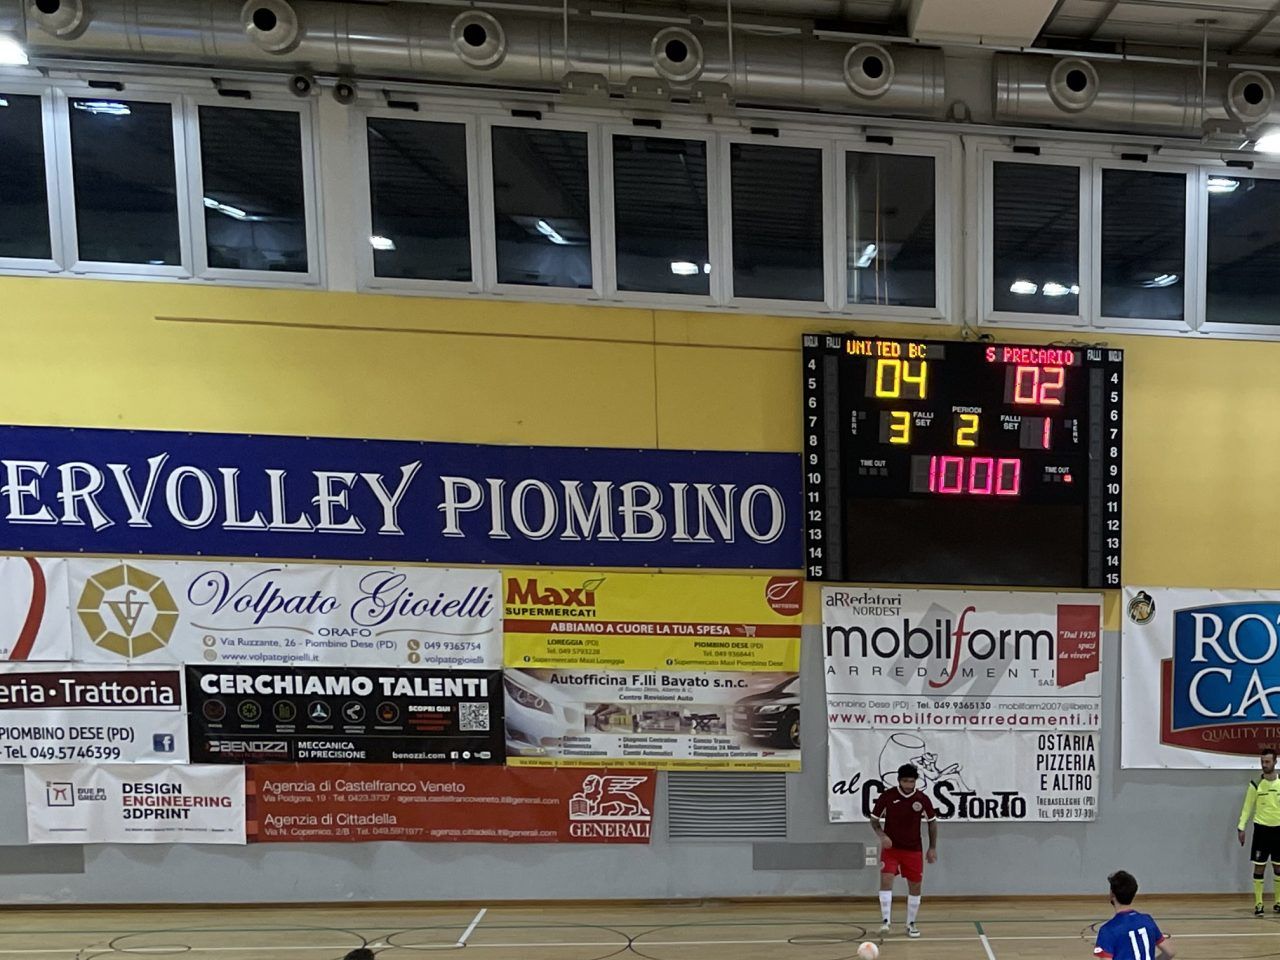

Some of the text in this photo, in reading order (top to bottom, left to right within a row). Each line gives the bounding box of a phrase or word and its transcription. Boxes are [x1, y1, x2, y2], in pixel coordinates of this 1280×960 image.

[908, 343, 927, 357] BC
[986, 347, 1075, 366] S PRECARIO
[808, 359, 816, 370] 4
[808, 378, 816, 389] 5
[874, 358, 928, 399] 04
[1110, 373, 1118, 384] 4
[1014, 365, 1064, 405] 02
[808, 397, 816, 408] 6
[1110, 392, 1118, 403] 5
[913, 411, 934, 419] FALLI
[952, 406, 982, 414] PERIODI
[1110, 410, 1118, 421] 6
[809, 416, 817, 427] 7
[1000, 415, 1021, 423] FALLI
[889, 411, 911, 443] 3
[956, 414, 979, 446] 2
[1042, 416, 1051, 449] 1
[1110, 429, 1118, 440] 7
[809, 435, 818, 446] 8
[1110, 447, 1118, 458] 8
[810, 454, 818, 465] 9
[1110, 465, 1118, 476] 9
[807, 473, 821, 484] 10
[1107, 483, 1120, 494] 10
[808, 492, 820, 502] 11
[437, 475, 786, 545] PIOMBINO
[1107, 501, 1119, 512] 11
[808, 510, 821, 521] 12
[1106, 520, 1120, 531] 12
[809, 529, 822, 540] 13
[1106, 538, 1119, 549] 13
[809, 547, 822, 558] 14
[1106, 556, 1119, 566] 14
[809, 565, 822, 577] 15
[1106, 574, 1119, 584] 15
[187, 568, 495, 627] Volpato Gioielli
[507, 577, 595, 607] Maxi
[505, 607, 597, 618] SUPERMERCATI
[852, 606, 902, 617] NORDEST
[318, 627, 372, 638] ORAFO
[550, 622, 731, 636] ABBIAMO A CUORE LA TUA SPESA
[220, 637, 235, 646] Via
[284, 638, 296, 647] 26
[305, 638, 348, 648] Piombino
[350, 640, 374, 649] Dese
[376, 640, 398, 650] (PD)
[424, 641, 481, 651] 049 9365754
[826, 606, 1054, 688] mobilform
[221, 653, 319, 664] www.volpatogioielli.it
[827, 665, 1055, 679] ARREDAMENTI
[200, 674, 489, 697] CERCHIAMO TALENTI
[550, 673, 627, 687] Autofficina
[661, 675, 709, 688] Bavato
[713, 677, 749, 688] s.n.c.
[58, 678, 174, 705] Trattoria
[828, 712, 1099, 726] www.mobilformarredamenti.it
[0, 726, 135, 744] PIOMBINO DESE (PD)
[1201, 727, 1259, 742] QUALITY
[220, 741, 288, 753] BENOZZI
[298, 741, 355, 750] MECCANICA
[1038, 734, 1095, 752] OSTARIA
[30, 746, 121, 760] 049.5746399
[298, 750, 366, 759] DI PRECISIONE
[392, 751, 446, 759] benozzi.com
[1036, 754, 1096, 772] PIZZERIA
[122, 783, 182, 794] DESIGN
[262, 779, 466, 794] Agenzia di Castelfranco Veneto
[832, 772, 861, 795] al
[1040, 775, 1093, 791] E ALTRO
[122, 795, 232, 808] ENGINEERING
[122, 808, 191, 820] 3DPRINT
[264, 813, 397, 828] Agenzia di Cittadella
[569, 823, 650, 837] GENERALI
